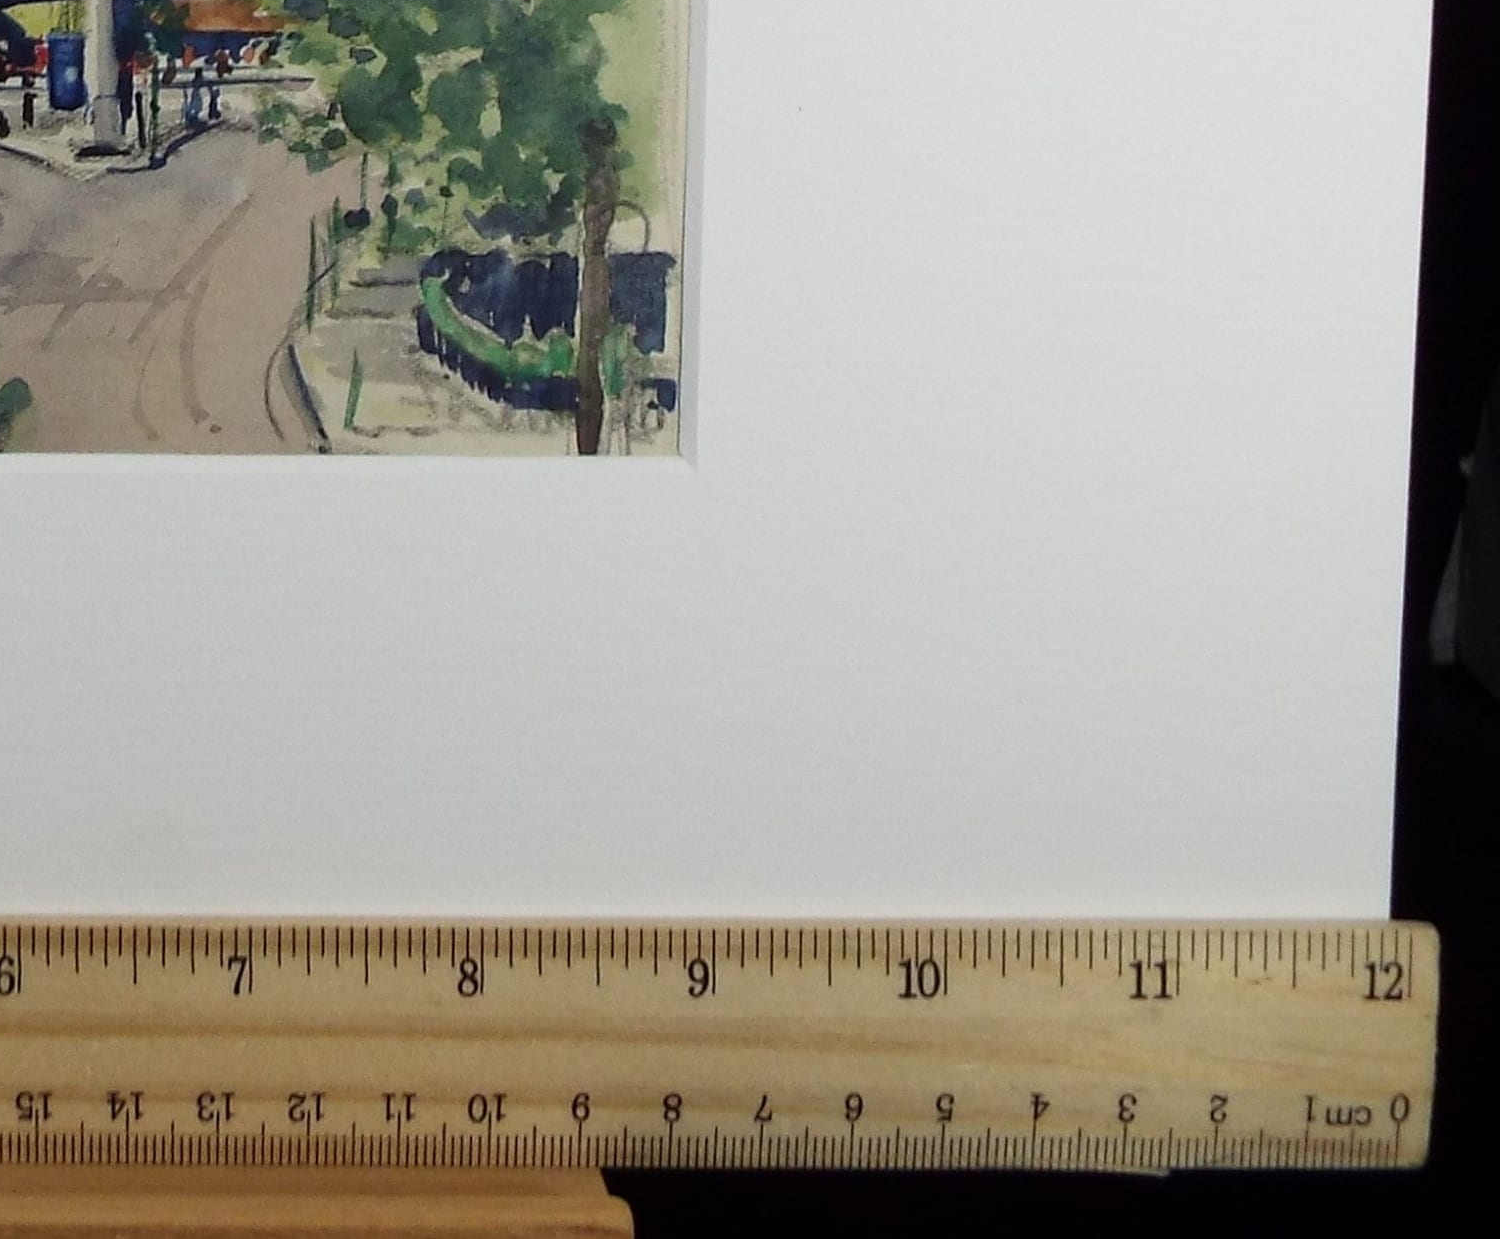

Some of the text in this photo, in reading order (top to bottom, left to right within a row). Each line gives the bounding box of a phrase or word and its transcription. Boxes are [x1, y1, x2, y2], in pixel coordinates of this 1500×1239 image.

[227, 957, 248, 995] 7
[458, 958, 480, 996] 8
[687, 960, 711, 998] 9
[899, 961, 941, 999] 10
[1130, 962, 1173, 1000] 11
[1362, 963, 1405, 1000] 12
[16, 1091, 52, 1121] 15
[108, 1091, 144, 1121] 14
[198, 1092, 235, 1121] 13
[288, 1093, 325, 1121] 12
[383, 1093, 417, 1122] 11
[468, 1092, 507, 1123] 10
[572, 1093, 590, 1121] 9
[663, 1093, 681, 1122] 8
[753, 1094, 772, 1122] 7
[845, 1093, 862, 1122] 6
[935, 1094, 953, 1123] 5
[1030, 1094, 1049, 1124] 4
[1118, 1095, 1136, 1124] 3
[1209, 1096, 1227, 1124] 2
[1305, 1096, 1316, 1125] 1
[1326, 1105, 1372, 1126] cm
[1390, 1095, 1409, 1125] 0
